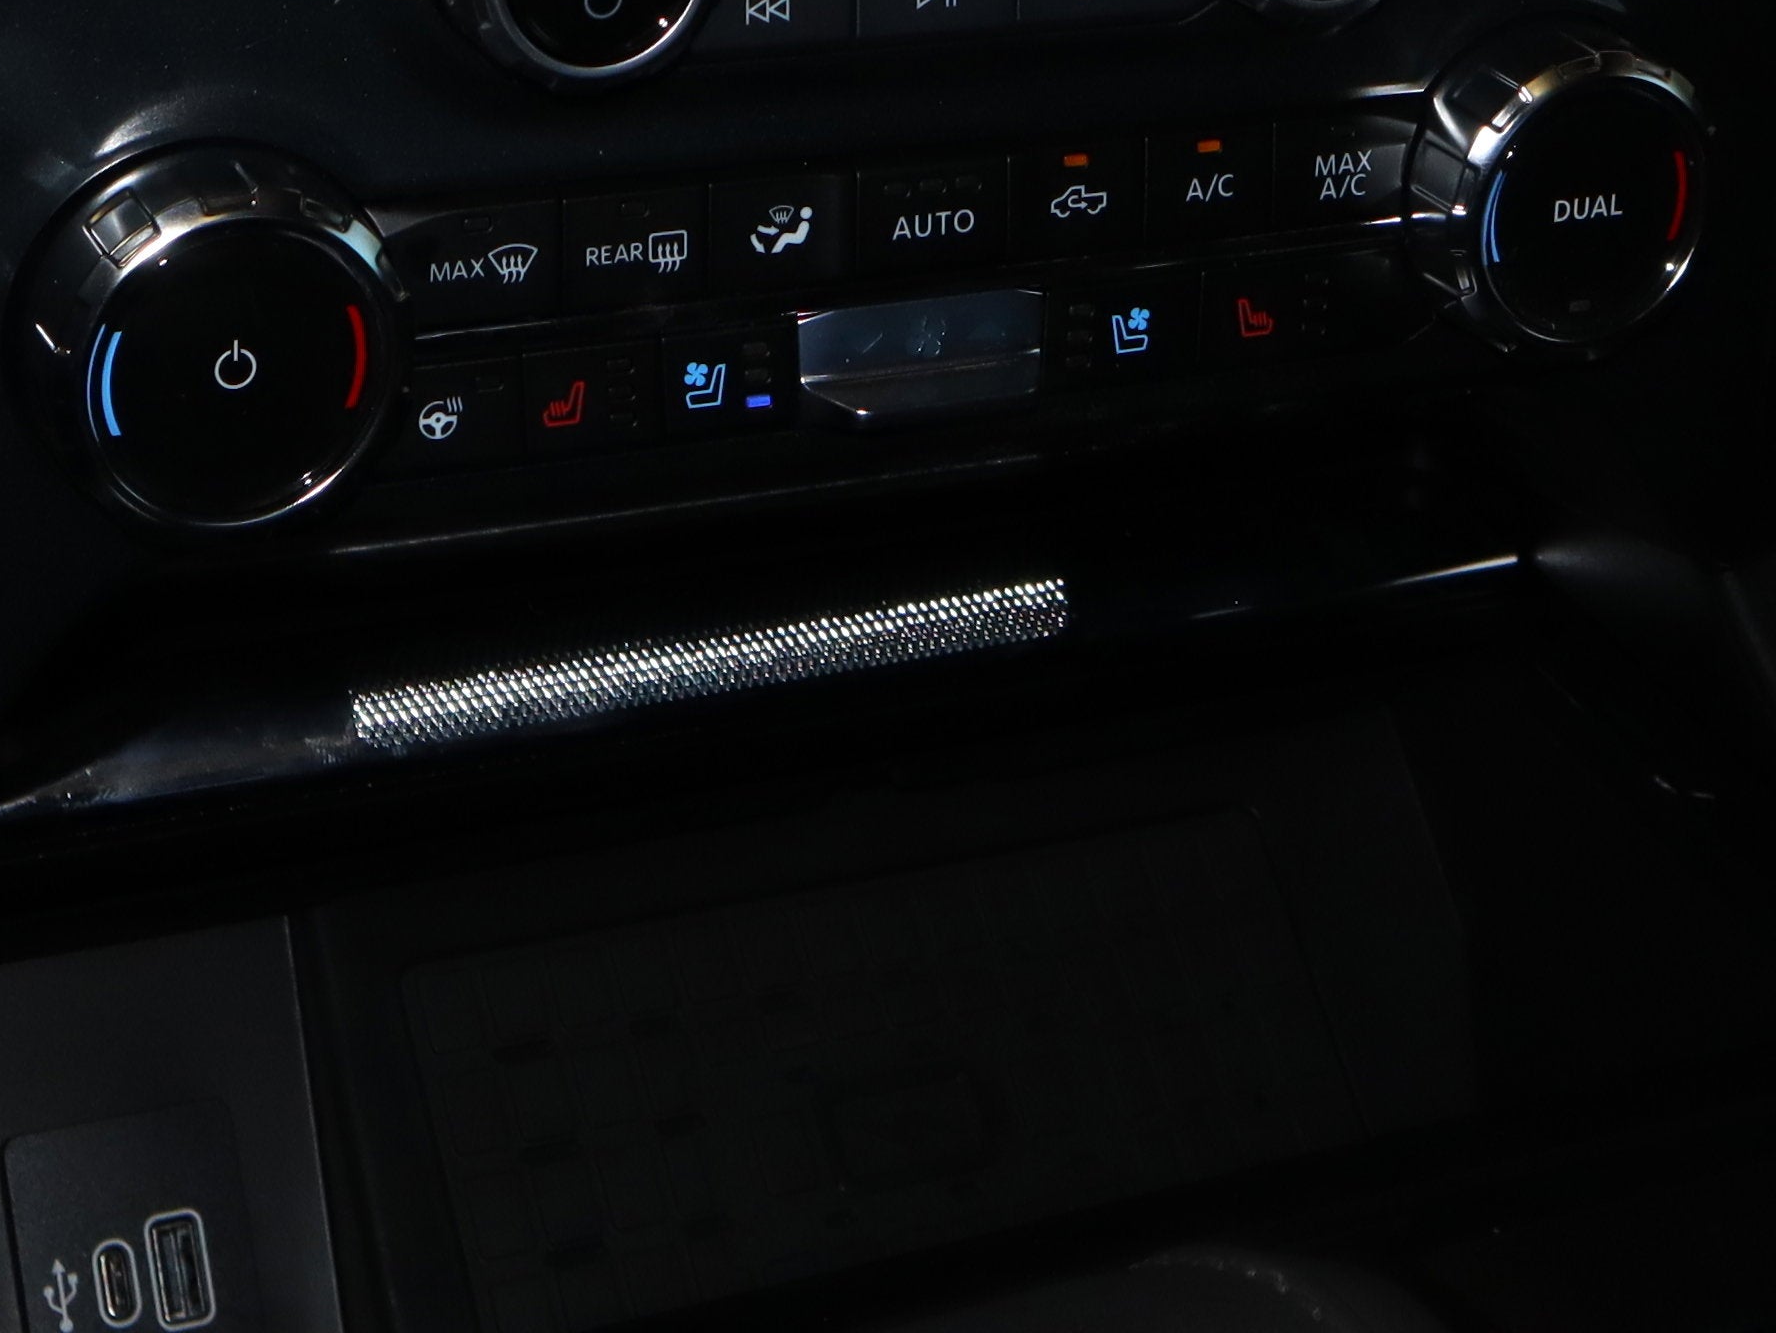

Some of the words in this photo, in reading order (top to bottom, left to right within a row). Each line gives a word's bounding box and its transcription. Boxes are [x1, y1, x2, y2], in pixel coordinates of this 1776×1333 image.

[1315, 150, 1373, 178] MAX
[1186, 172, 1235, 203] A/C
[1319, 173, 1366, 201] A/C
[1553, 193, 1623, 223] DUAL
[892, 209, 976, 241] AUTO
[585, 242, 643, 267] REAR
[429, 256, 486, 283] MAX
